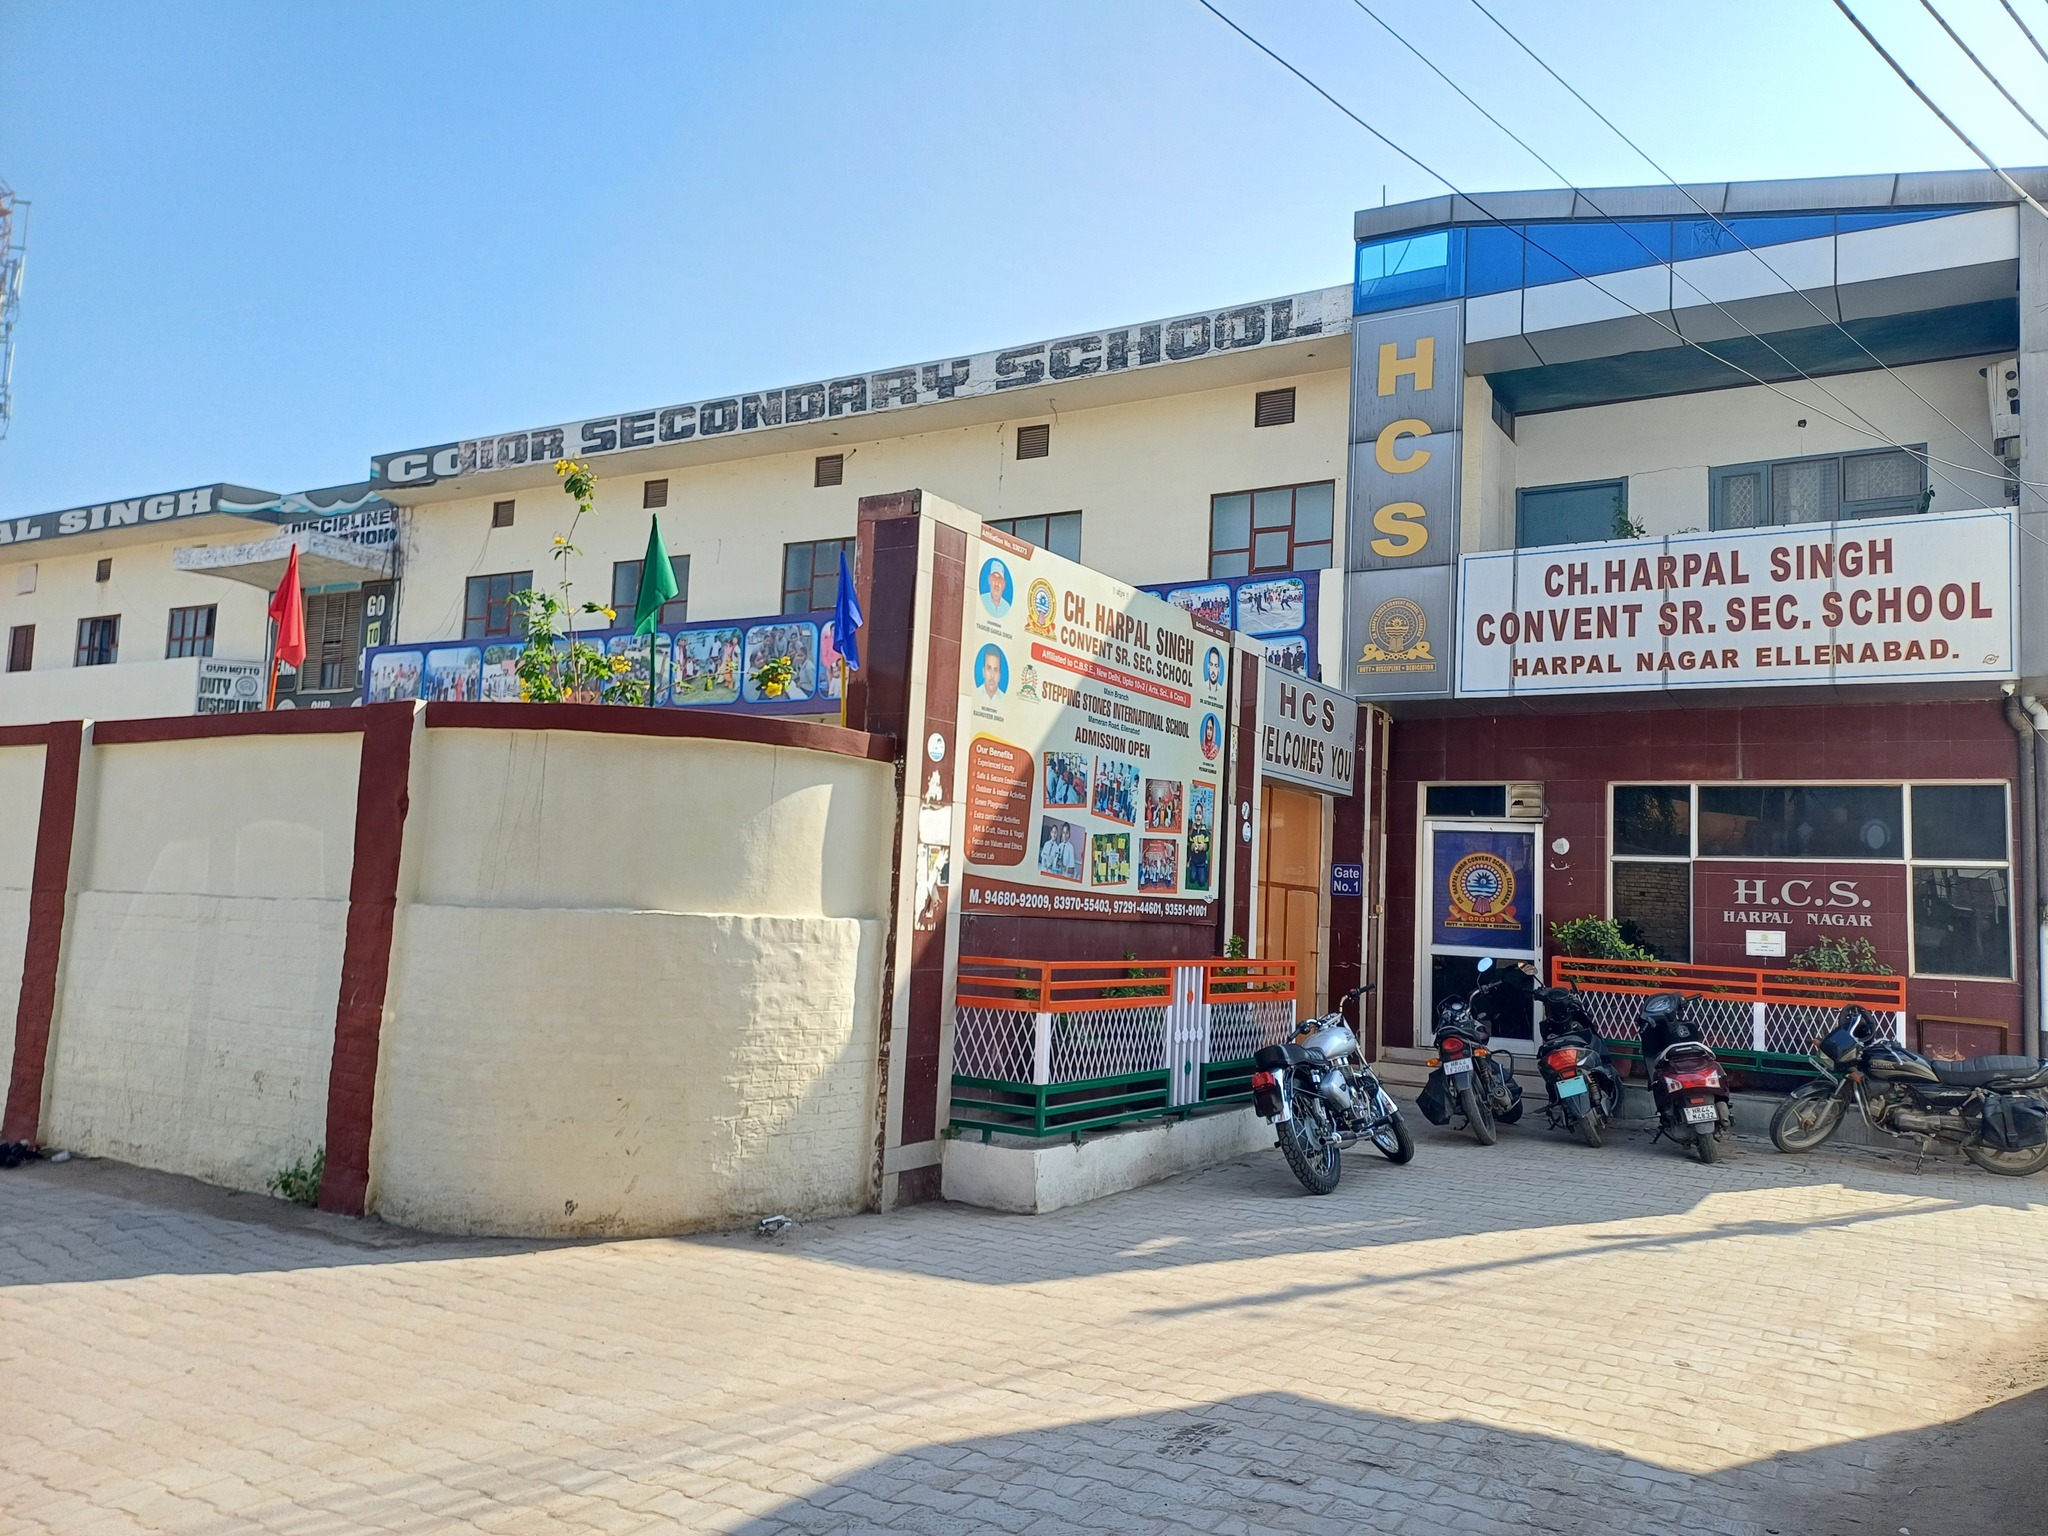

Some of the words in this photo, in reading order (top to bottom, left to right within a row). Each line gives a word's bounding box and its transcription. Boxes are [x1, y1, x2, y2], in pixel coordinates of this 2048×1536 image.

[581, 359, 970, 455] SECONDARY
[996, 299, 1322, 390] SCHOOL
[58, 487, 213, 534] SINGH
[1769, 538, 1893, 582] SINGH
[367, 595, 385, 617] GO
[1476, 603, 1642, 646] CONVENT
[1822, 582, 1992, 628] SCHOOL
[368, 624, 378, 644] TO
[1064, 590, 1090, 628] CH.
[1096, 603, 1150, 651] HARPAL
[1156, 628, 1194, 666] SINGH
[1061, 626, 1112, 660] CONVENT
[1115, 646, 1130, 667] SR.
[1133, 652, 1154, 674] SEC.
[1156, 661, 1192, 688] SCHOOL
[1512, 654, 1622, 677] HARPAL
[1636, 648, 1739, 672] NAGAR
[1756, 638, 1960, 666] ELLENABAD.
[1042, 650, 1066, 666] Affiliated
[1066, 657, 1073, 667] to
[1096, 668, 1108, 678] New
[1108, 670, 1122, 682] Delhi,
[1122, 676, 1134, 686] Upto
[200, 676, 231, 695] DUTY
[1104, 688, 1114, 696] Main
[1114, 690, 1129, 702] Branch
[1042, 680, 1080, 708] STEPPING
[1082, 694, 1111, 718] STONES
[1113, 702, 1164, 732] INTERNATIONAL
[1166, 717, 1190, 738] SCHOOL
[1278, 680, 1336, 734] HCS
[1108, 721, 1120, 732] Road,
[1120, 724, 1140, 736] Ellenabad
[976, 744, 988, 754] Our
[989, 746, 1014, 760] Benefits
[1074, 726, 1126, 754] ADMISSION
[1128, 740, 1150, 759] OPEN
[978, 758, 1001, 770] Experienced
[1001, 762, 1015, 774] Faculty
[1330, 744, 1352, 783] YOU
[976, 771, 986, 780] Safe
[990, 774, 1004, 783] Secure
[1004, 776, 1028, 788] Environment
[976, 784, 992, 794] Outdoor
[996, 788, 1009, 797] Indoor
[1009, 790, 1026, 800] Activities
[975, 797, 986, 806] Green
[987, 799, 1009, 810] Playground
[974, 810, 984, 819] Extra
[984, 813, 1003, 821] curricular
[1003, 816, 1020, 824] Activities
[972, 836, 984, 846] Focus
[990, 839, 1003, 848] Values
[1003, 841, 1011, 849] and
[1011, 842, 1023, 850] Ethics
[971, 850, 986, 859] Science
[987, 852, 995, 860] Lab
[1468, 856, 1492, 864] CONVENT
[1334, 868, 1360, 880] Gate
[968, 889, 982, 904] M.
[984, 890, 1052, 911] 94680-92009,
[1053, 896, 1112, 916] 83970-55403,
[1113, 900, 1164, 918] 97291-44601,
[1164, 903, 1207, 918] 93551-91001
[1732, 879, 1871, 908] H.C.S.
[1723, 910, 1794, 924] HARPAL
[1806, 914, 1873, 927] NAGAR
